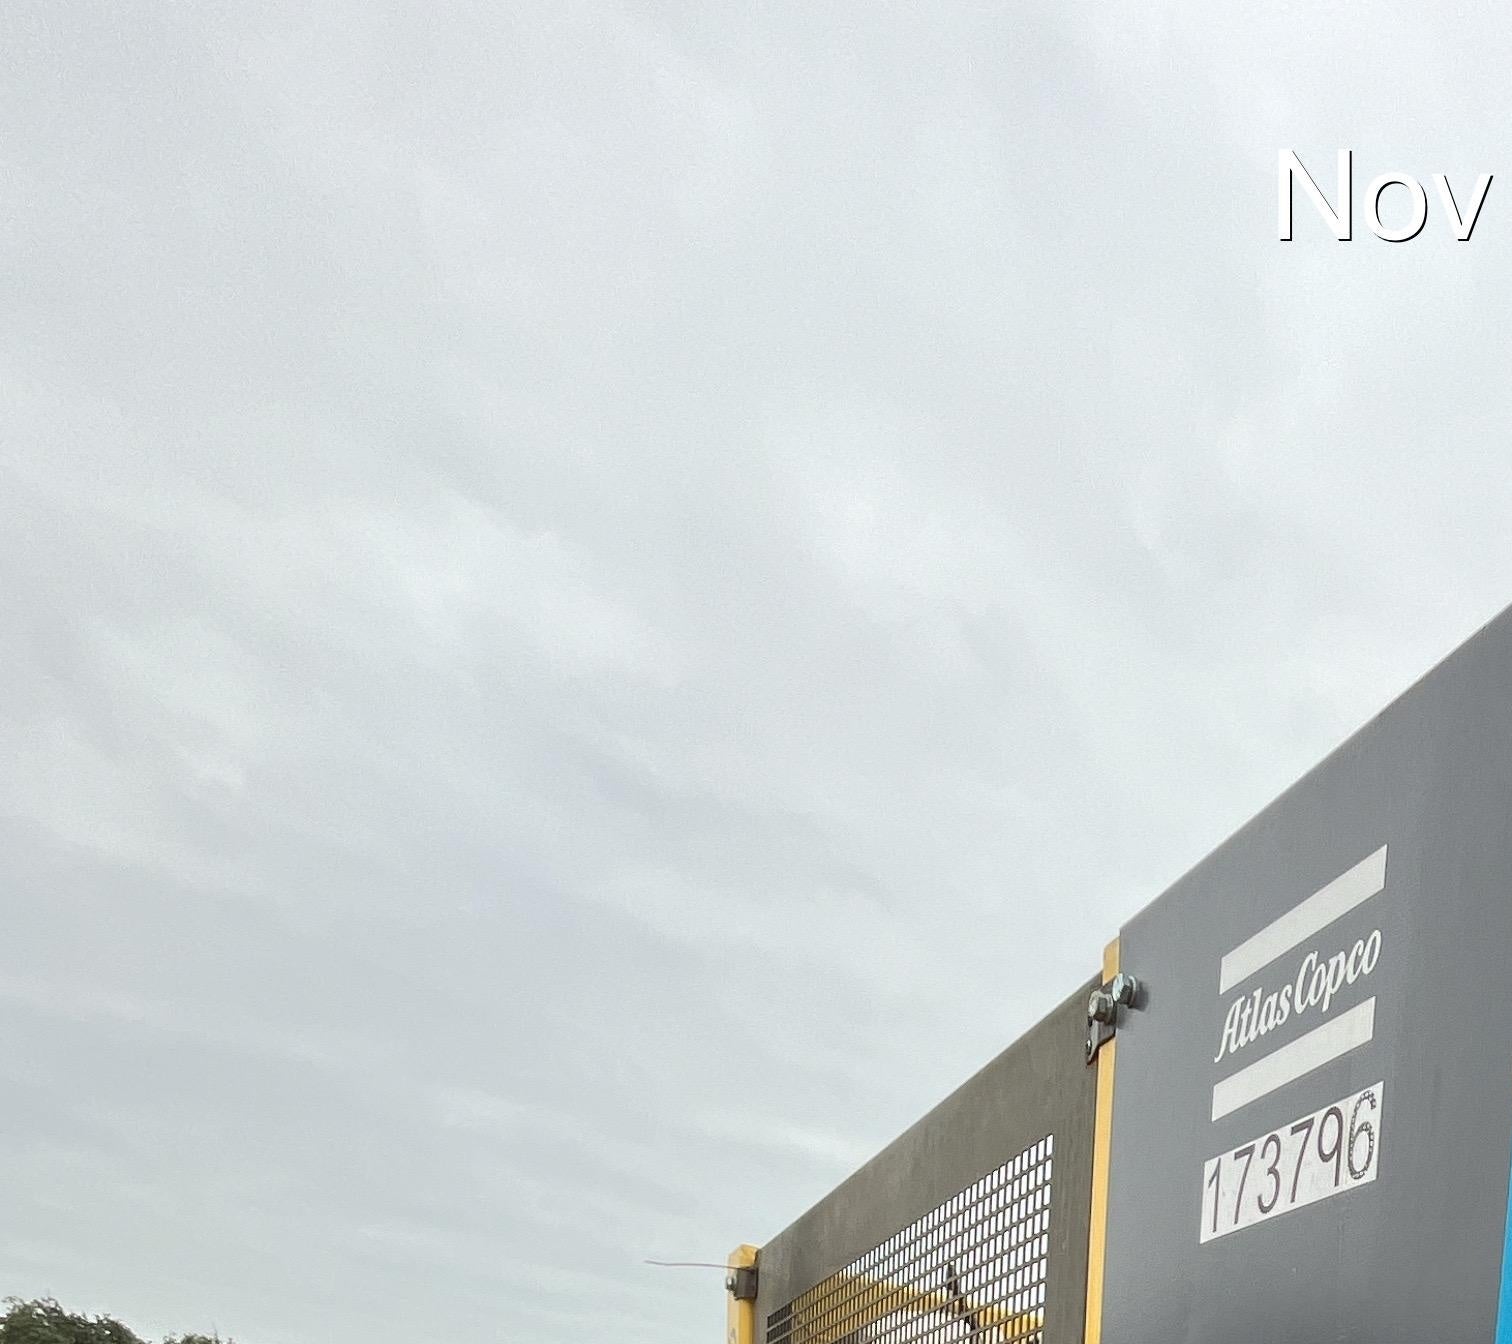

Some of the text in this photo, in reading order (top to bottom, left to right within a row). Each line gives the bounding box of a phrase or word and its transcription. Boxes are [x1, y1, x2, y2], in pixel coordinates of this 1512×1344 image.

[1213, 929, 1382, 1064] Atlas Copco
[1206, 1089, 1378, 1234] 173796
